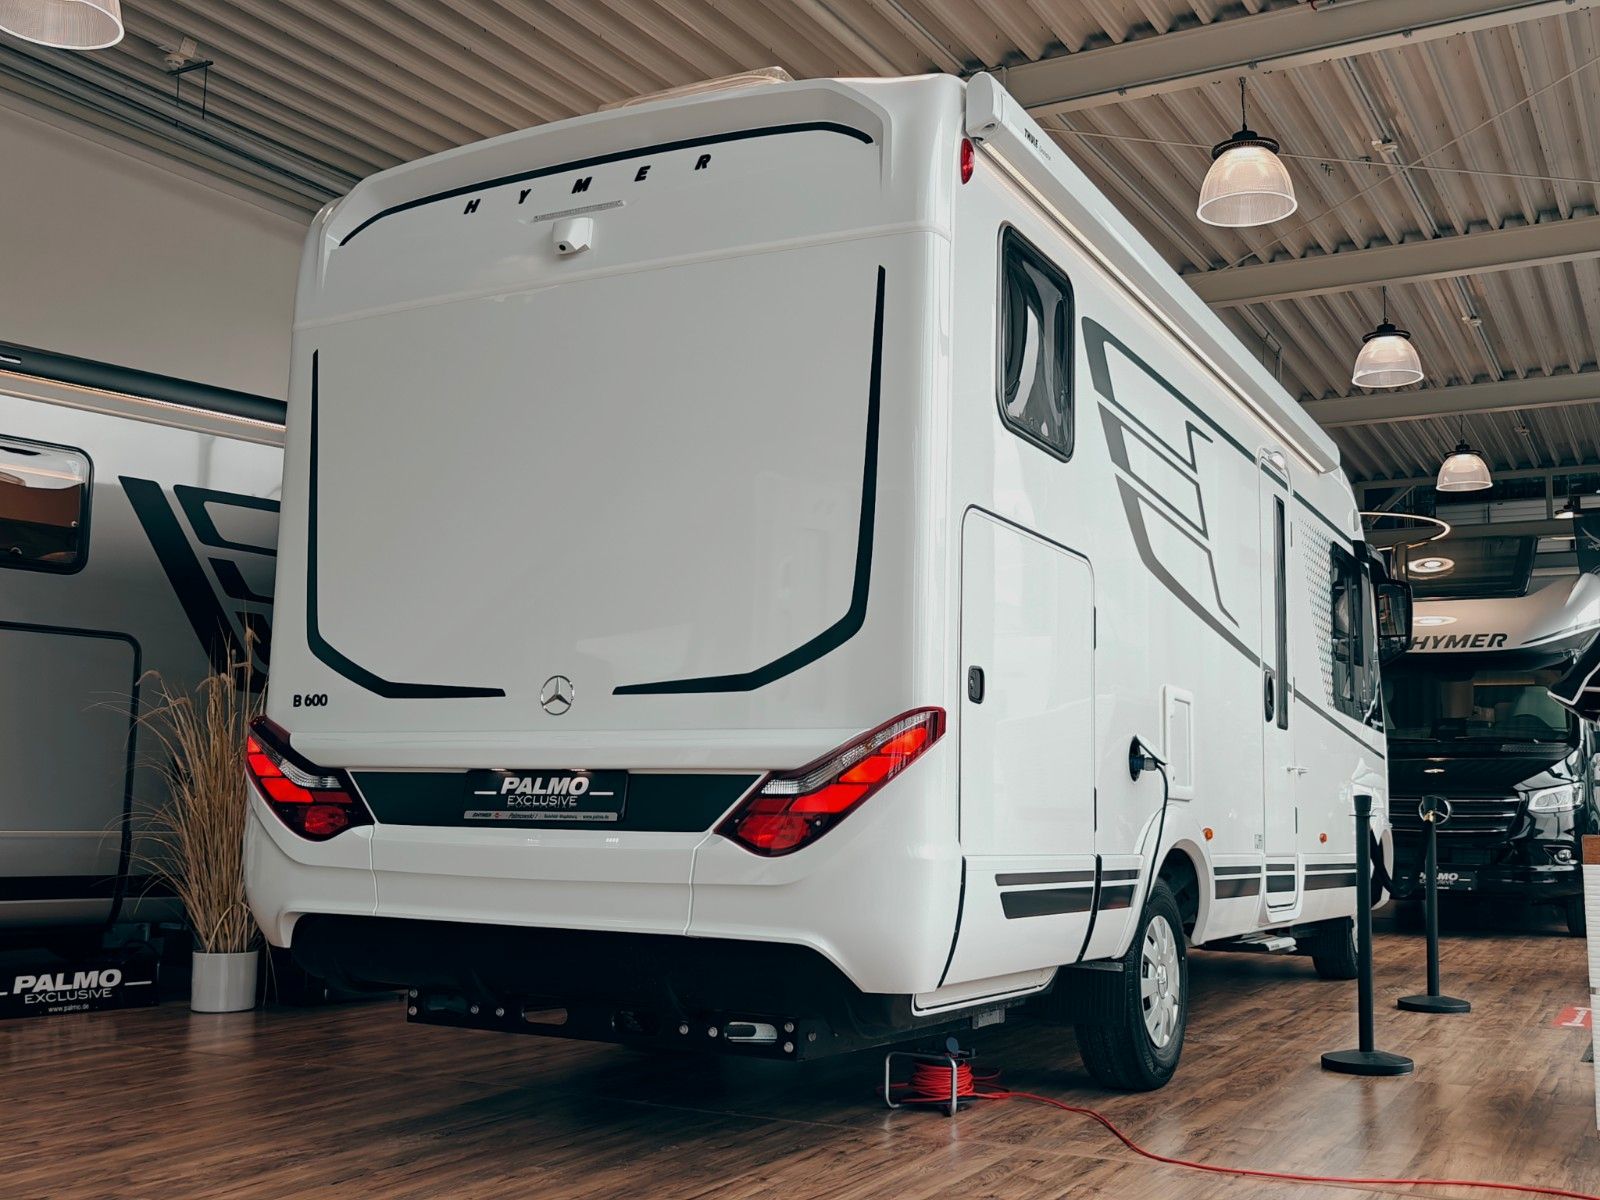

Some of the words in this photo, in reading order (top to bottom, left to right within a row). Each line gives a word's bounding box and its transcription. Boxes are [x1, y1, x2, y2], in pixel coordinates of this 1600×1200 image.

[463, 153, 712, 215] HYMER
[1408, 633, 1508, 651] HYMER
[292, 694, 302, 708] B
[304, 693, 328, 707] 600
[500, 776, 590, 795] PALMO
[507, 795, 578, 806] EXCLUSIVE
[13, 968, 122, 994] PALMO
[24, 987, 113, 1004] EXCLUSIVE
[48, 1003, 90, 1013] www.palmo.de
